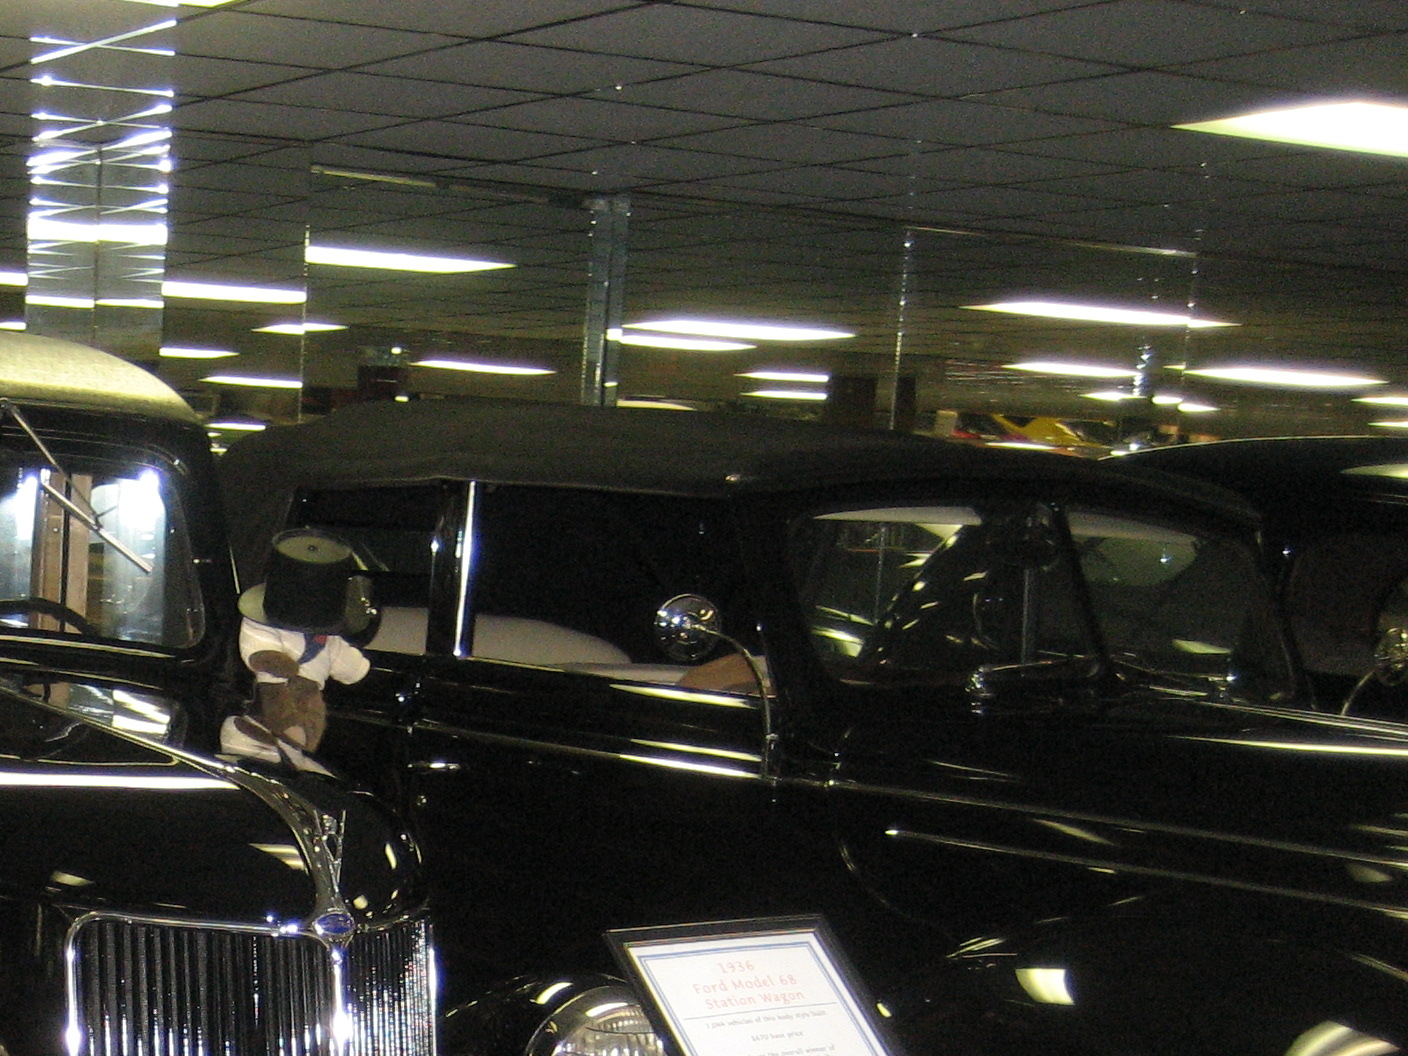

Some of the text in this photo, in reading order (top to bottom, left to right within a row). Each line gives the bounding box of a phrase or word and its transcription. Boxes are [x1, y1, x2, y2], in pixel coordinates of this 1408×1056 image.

[718, 961, 757, 974] 1936
[693, 974, 798, 995] Ford Model 68
[705, 990, 805, 1010] Station Wagon
